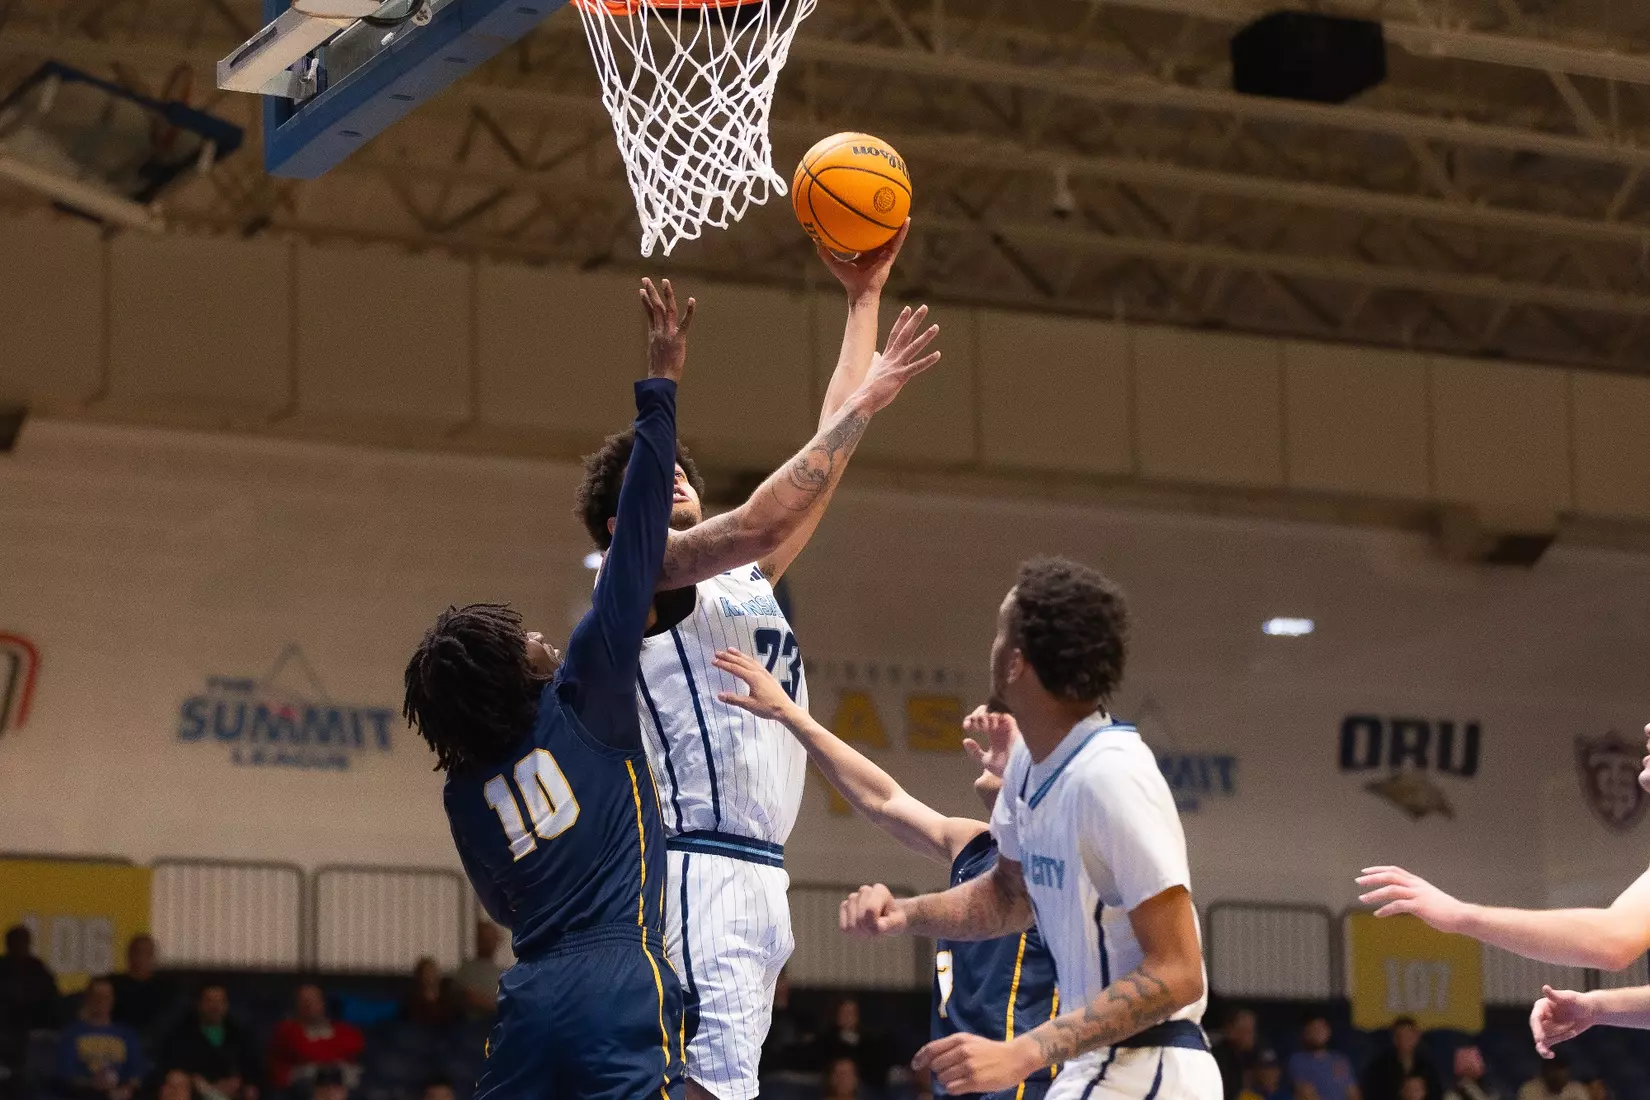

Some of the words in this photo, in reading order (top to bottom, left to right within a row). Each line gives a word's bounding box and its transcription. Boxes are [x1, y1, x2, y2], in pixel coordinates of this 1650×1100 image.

[179, 697, 396, 752] SUMMIT
[1341, 714, 1481, 778] ORU
[484, 748, 581, 863] 10
[1384, 956, 1452, 1013] 107
